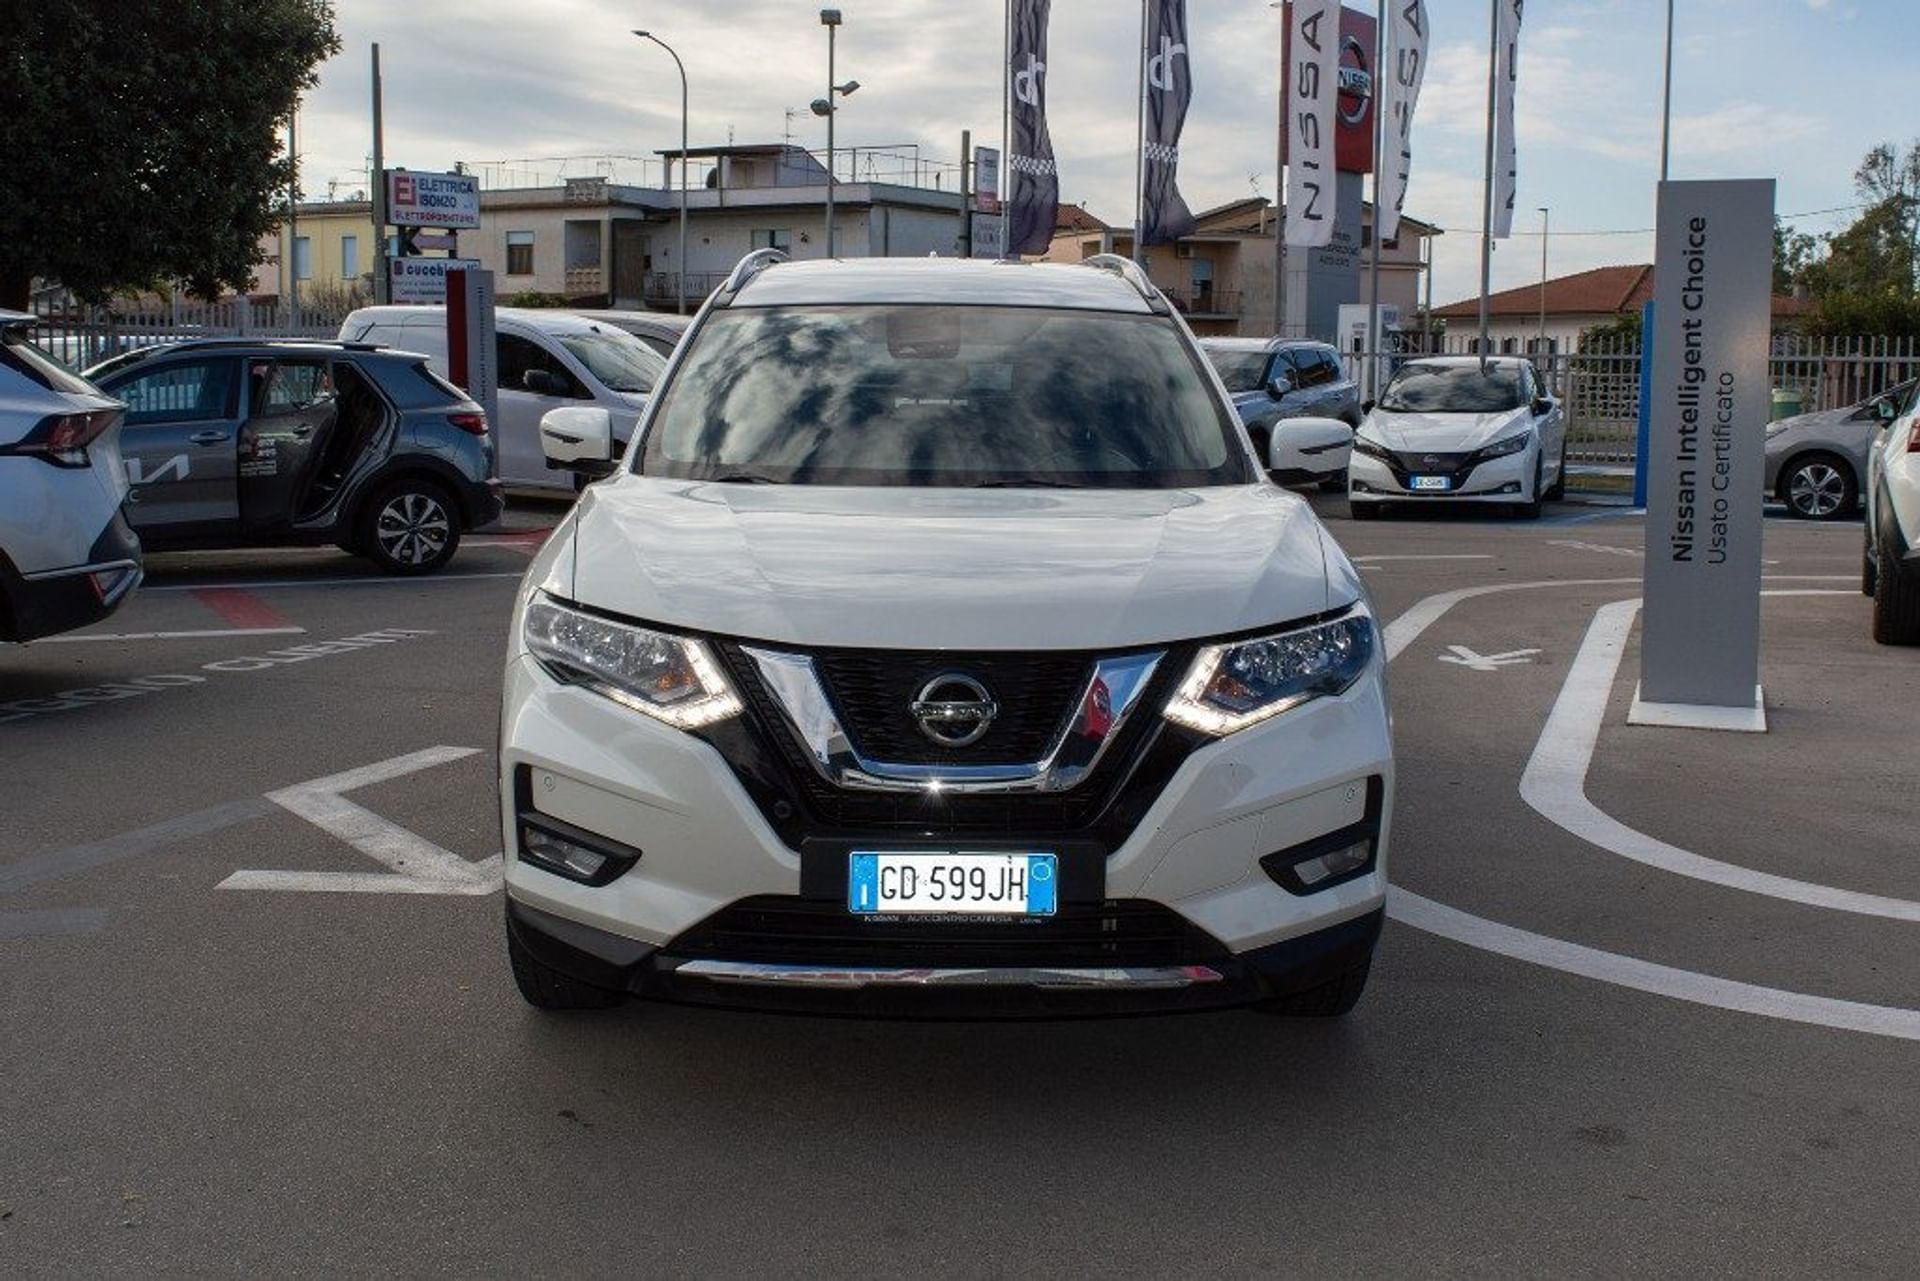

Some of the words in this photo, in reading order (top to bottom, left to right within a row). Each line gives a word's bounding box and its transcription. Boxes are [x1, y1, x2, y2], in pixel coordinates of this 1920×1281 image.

[1298, 8, 1325, 221] NISSA
[418, 178, 473, 194] ELETTRICA
[419, 194, 457, 208] ISONZO
[1682, 216, 1707, 311] Choice
[1677, 319, 1706, 461] Intelligent
[1712, 373, 1735, 491] Certificato
[1671, 470, 1697, 562] Nissan
[1708, 498, 1728, 564] Usato
[880, 866, 917, 900] GD
[929, 866, 1024, 902] 599JH
